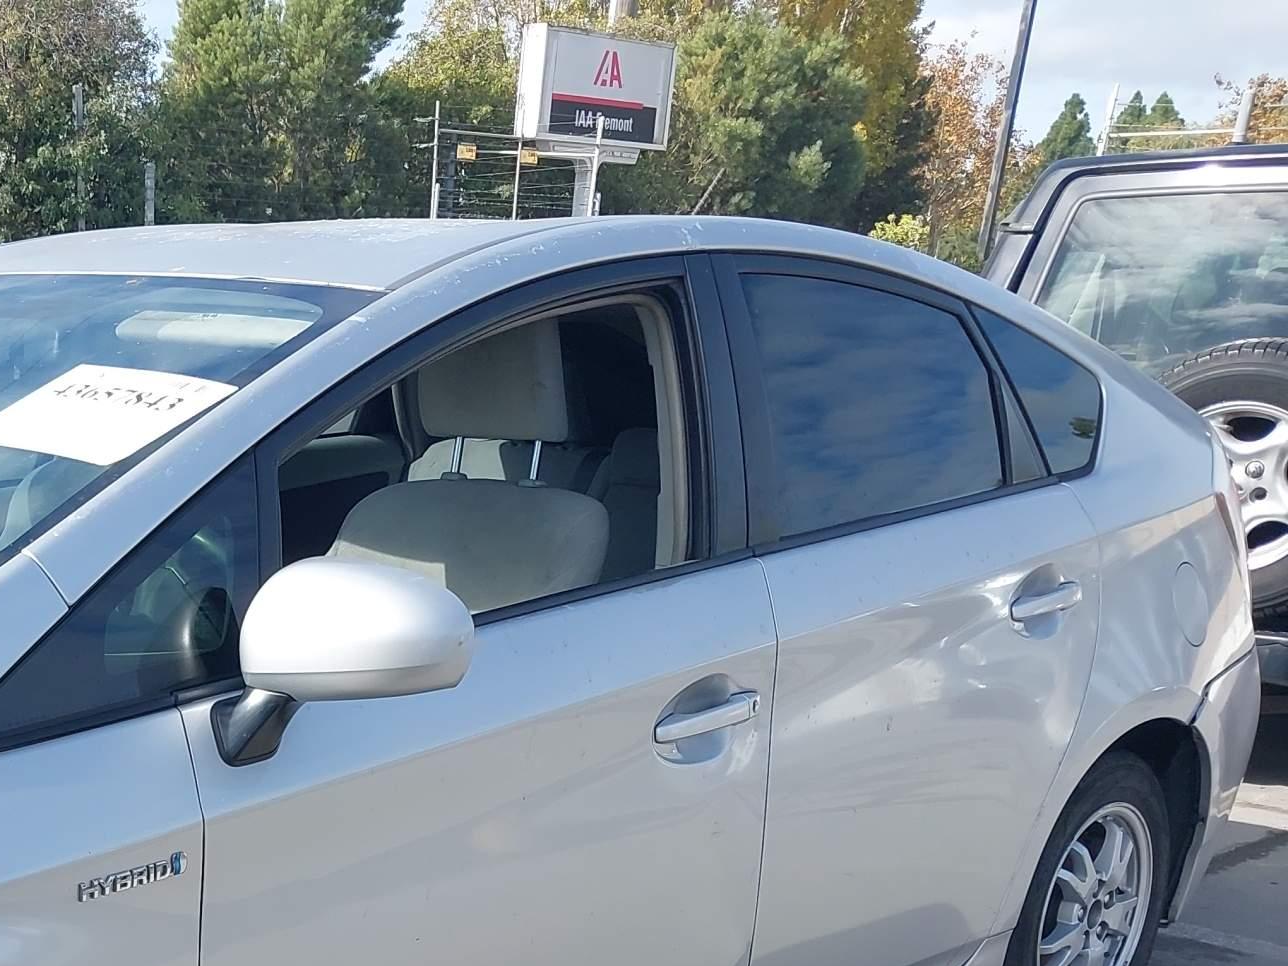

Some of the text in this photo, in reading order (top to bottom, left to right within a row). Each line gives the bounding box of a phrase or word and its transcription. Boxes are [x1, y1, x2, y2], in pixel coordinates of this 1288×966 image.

[575, 109, 633, 132] IAA Femont
[78, 860, 172, 902] HYBRID
